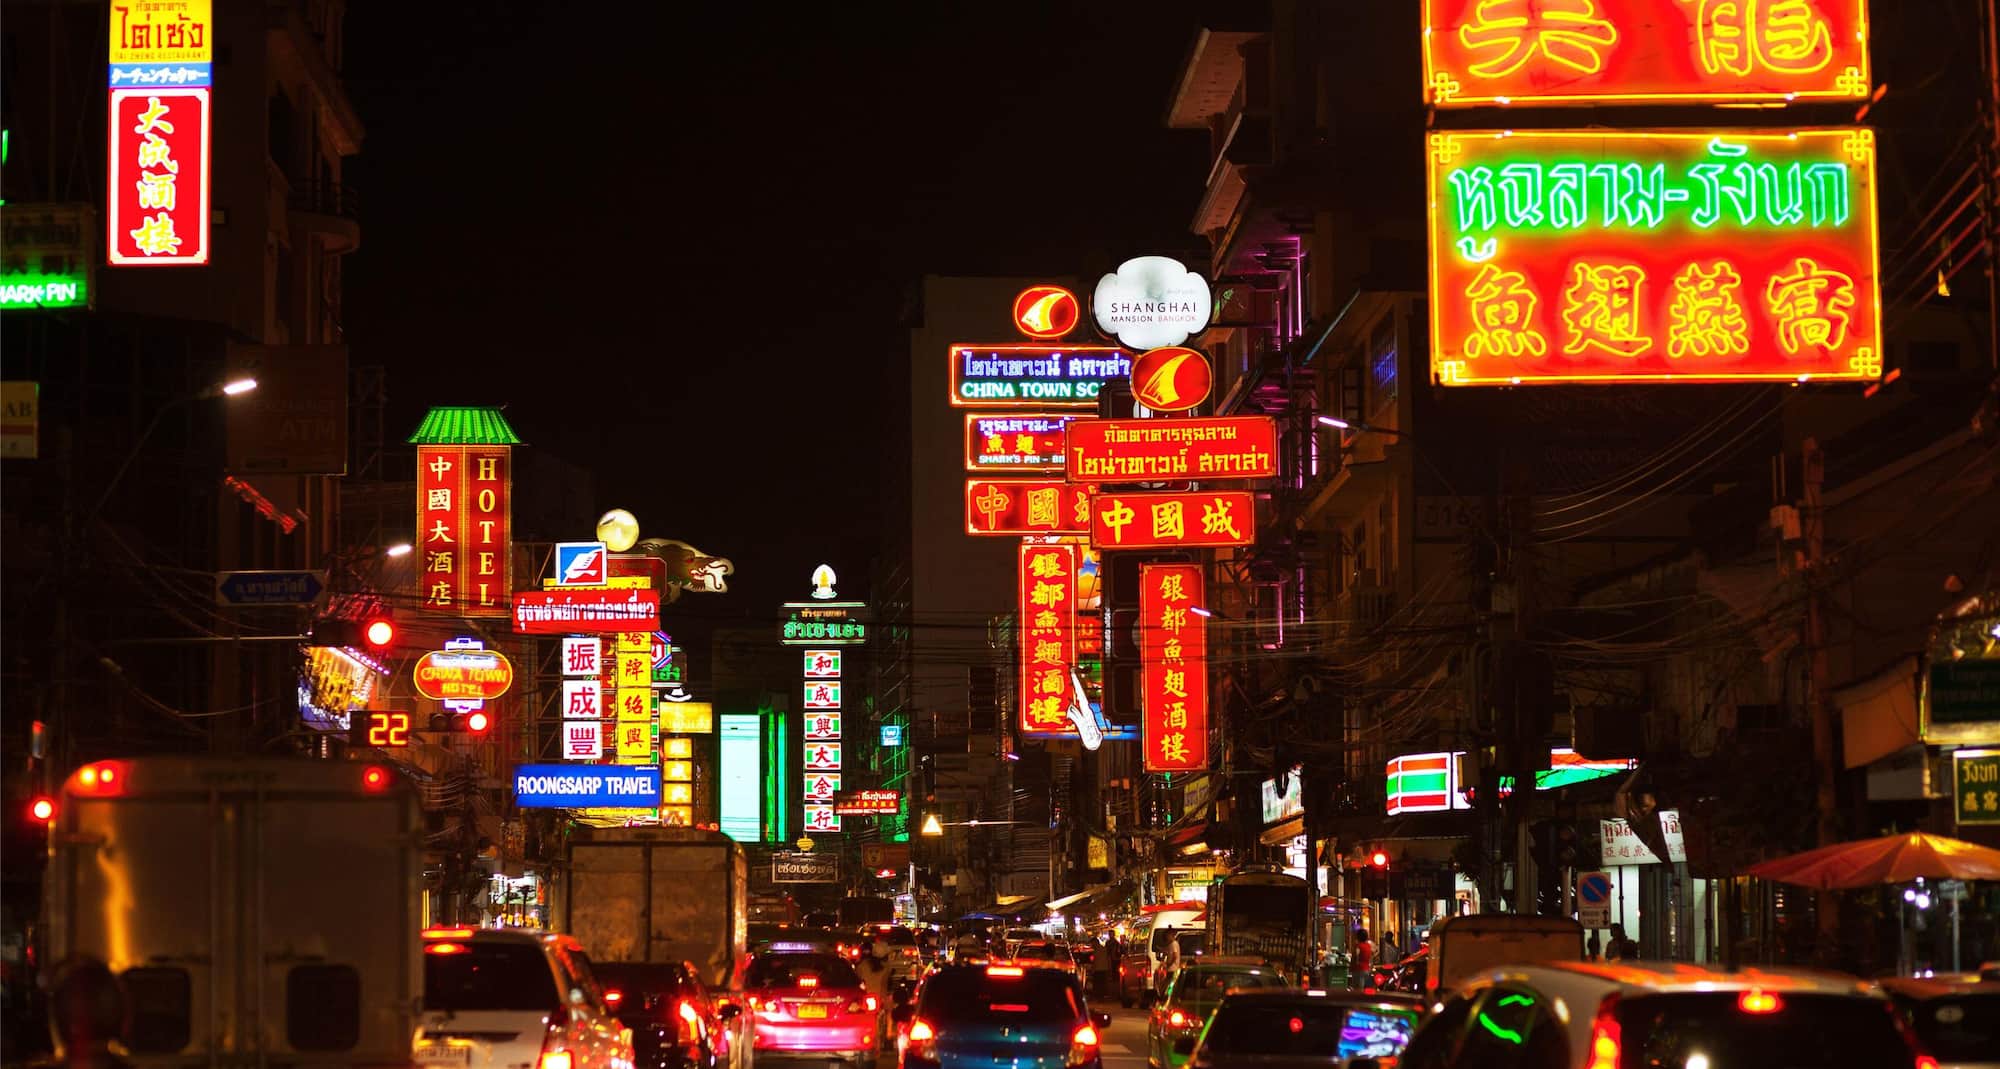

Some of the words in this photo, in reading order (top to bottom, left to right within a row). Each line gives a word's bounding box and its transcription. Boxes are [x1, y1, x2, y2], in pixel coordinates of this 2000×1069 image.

[1111, 302, 1196, 313] SHANGHAI
[1111, 315, 1153, 323] MANSION
[1463, 259, 1855, 358] 魚翅燕窩
[961, 382, 1015, 398] CHINA
[1019, 382, 1071, 398] TOWN
[1076, 382, 1099, 398] SC
[1073, 446, 1188, 475] ไชน่าทาวน์
[1199, 445, 1269, 472] สกาล่า
[427, 456, 455, 606] 中國大酒店
[477, 458, 497, 606] HOTEL
[1101, 498, 1240, 544] 中國城
[1028, 553, 1068, 726] 銀都魚翅酒樓
[421, 667, 463, 680] CHINA
[469, 669, 507, 682] TOWN
[1160, 573, 1190, 763] 銀都魚翅酒樓
[442, 683, 484, 695] HOTEL
[567, 643, 597, 756] 振成豐
[370, 714, 408, 745] 22
[518, 776, 602, 795] ROONGSARP
[606, 776, 656, 795] TRAVEL
